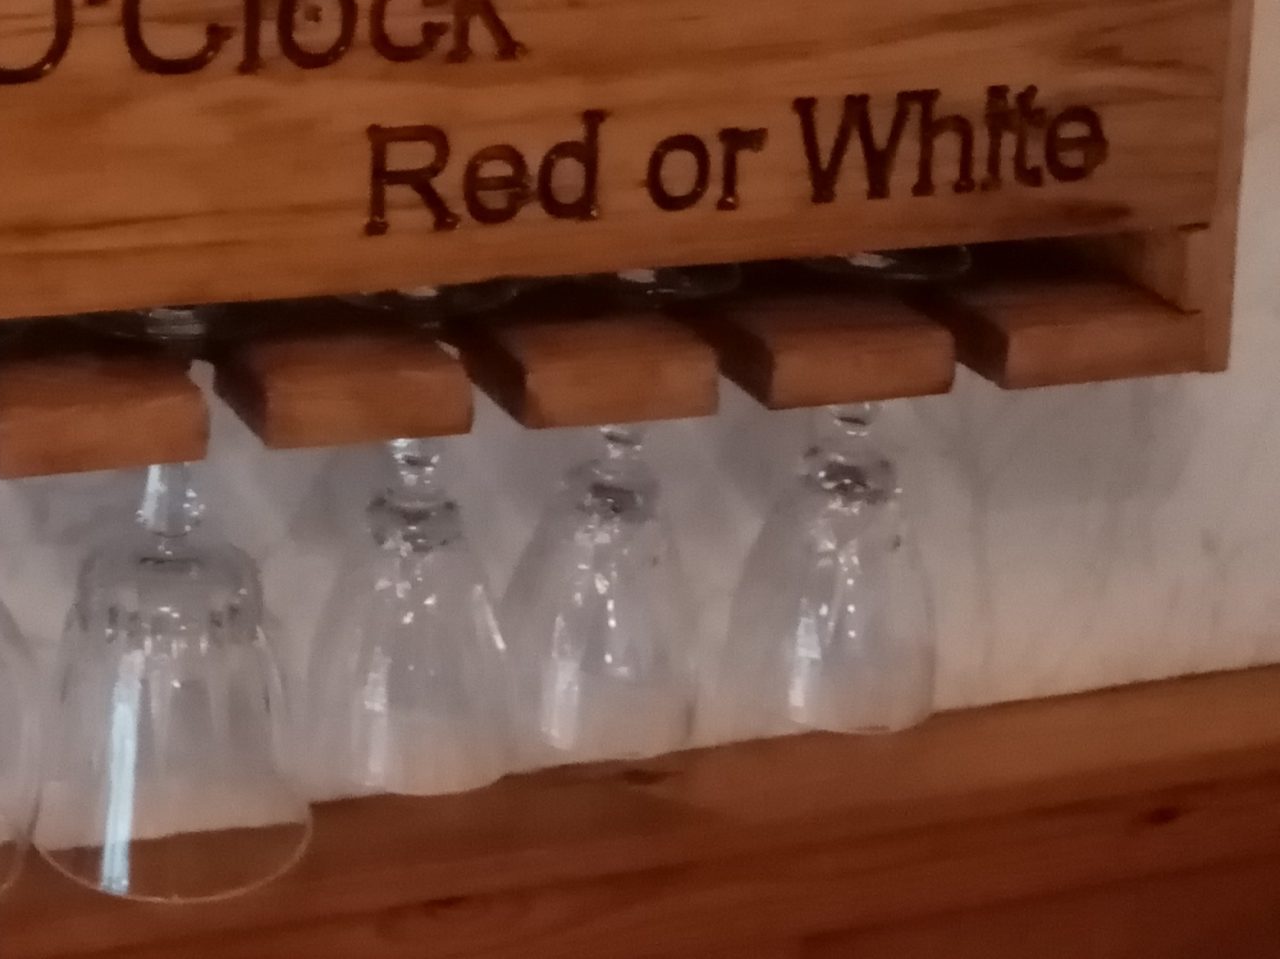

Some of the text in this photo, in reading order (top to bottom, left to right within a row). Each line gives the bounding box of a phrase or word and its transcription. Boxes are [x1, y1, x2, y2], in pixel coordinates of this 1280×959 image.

[363, 84, 1109, 236] Red or White
